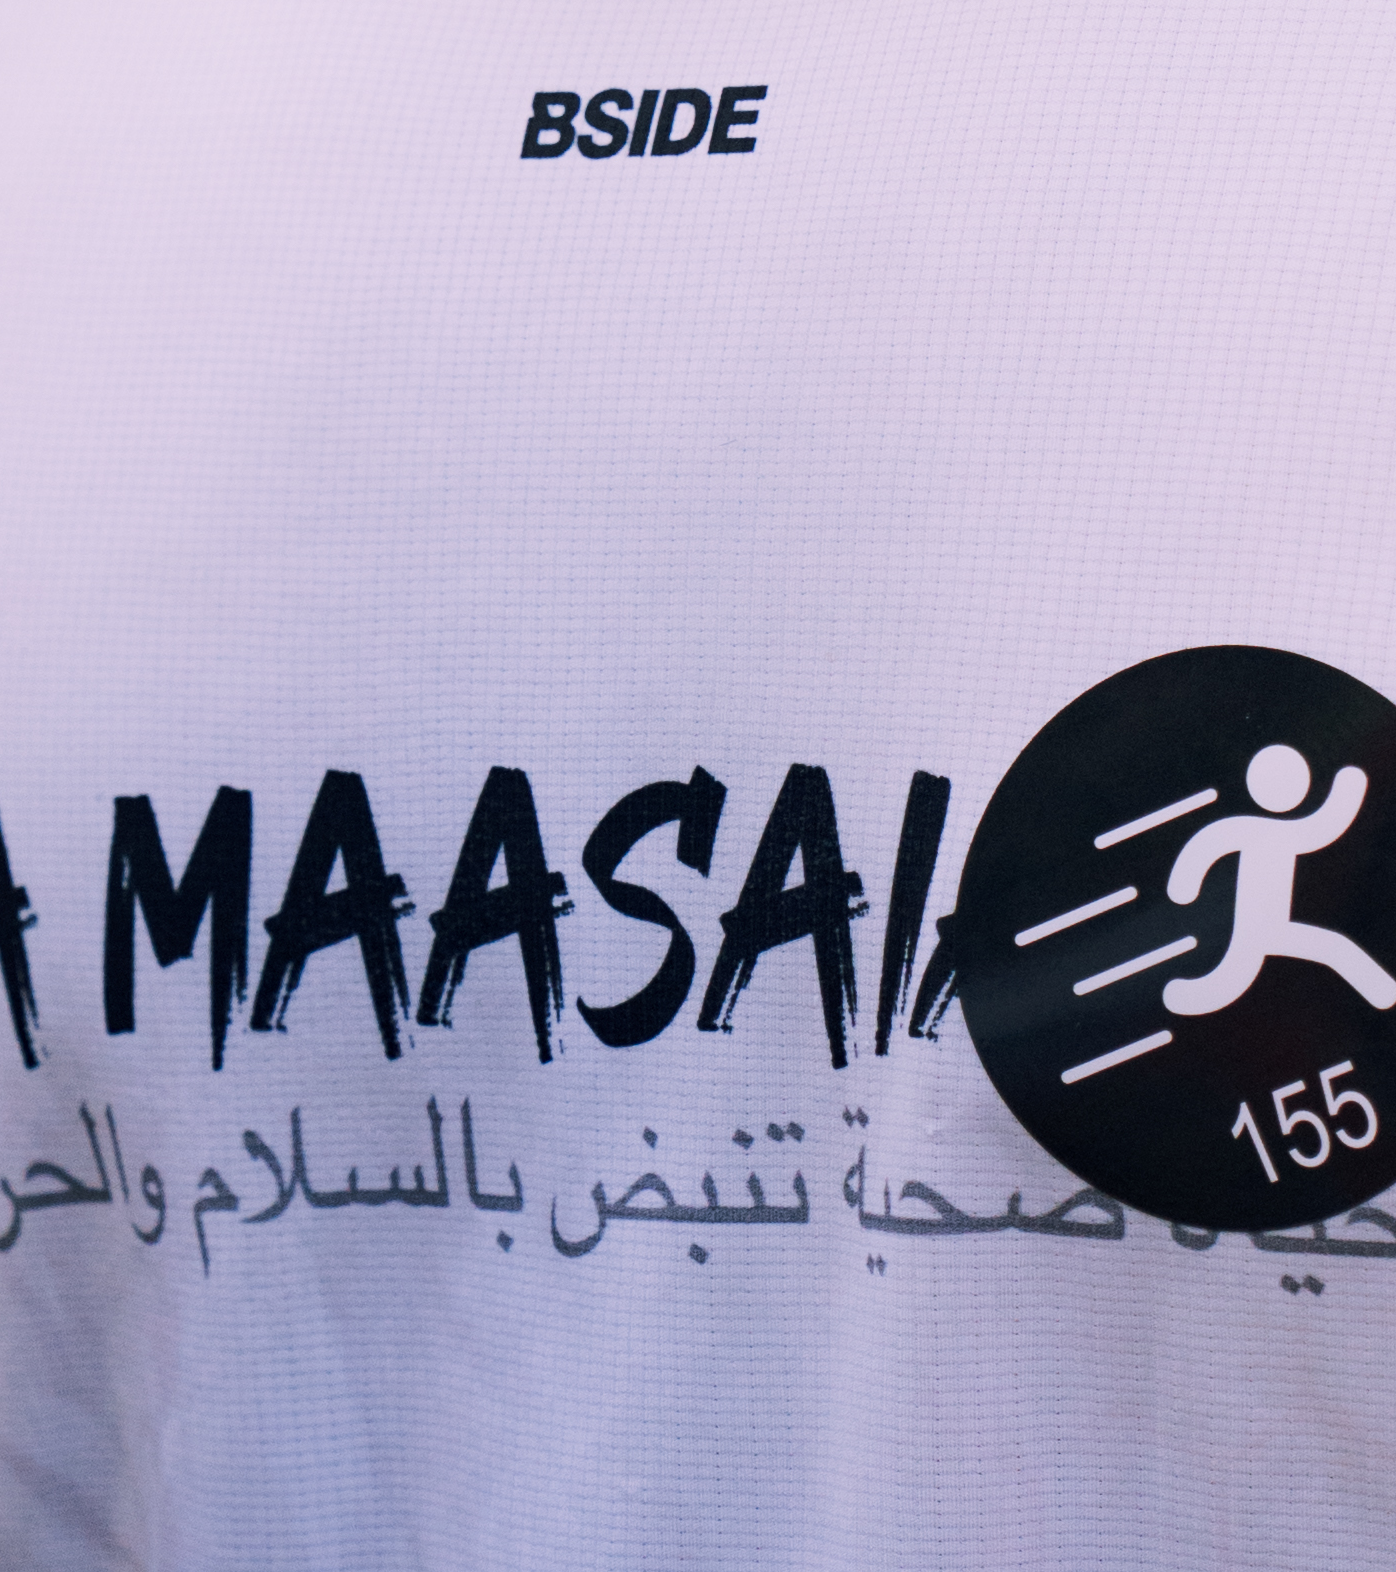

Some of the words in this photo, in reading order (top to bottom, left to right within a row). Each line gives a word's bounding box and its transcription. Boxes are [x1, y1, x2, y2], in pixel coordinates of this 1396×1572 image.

[520, 84, 769, 160] BSIDE
[193, 1094, 524, 1279] بالسلام
[549, 1119, 810, 1265] تنبض
[843, 1104, 1127, 1276] صحية
[1230, 1060, 1380, 1184] 155
